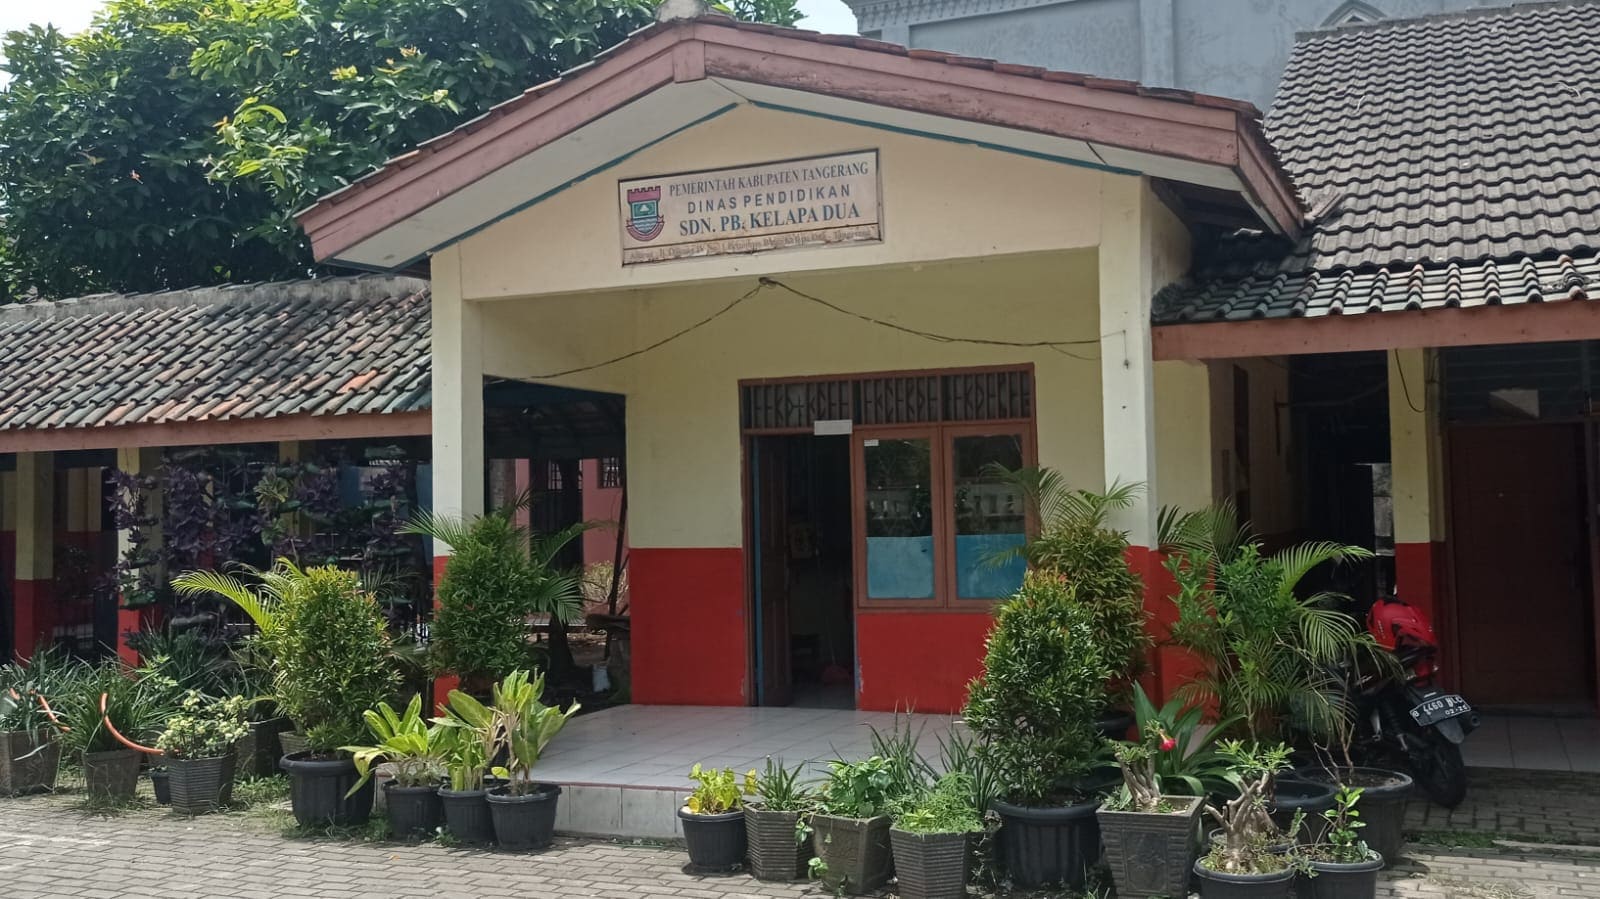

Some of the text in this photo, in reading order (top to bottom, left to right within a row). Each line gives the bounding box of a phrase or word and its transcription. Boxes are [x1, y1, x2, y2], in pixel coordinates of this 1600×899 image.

[669, 161, 869, 198] PEMERINTAH KABUPATEN TANGERANG
[687, 183, 850, 214] DINAS PENDIDIKAN
[680, 217, 716, 237] SDN.
[750, 206, 819, 229] KELAPA
[822, 202, 861, 222] DUA
